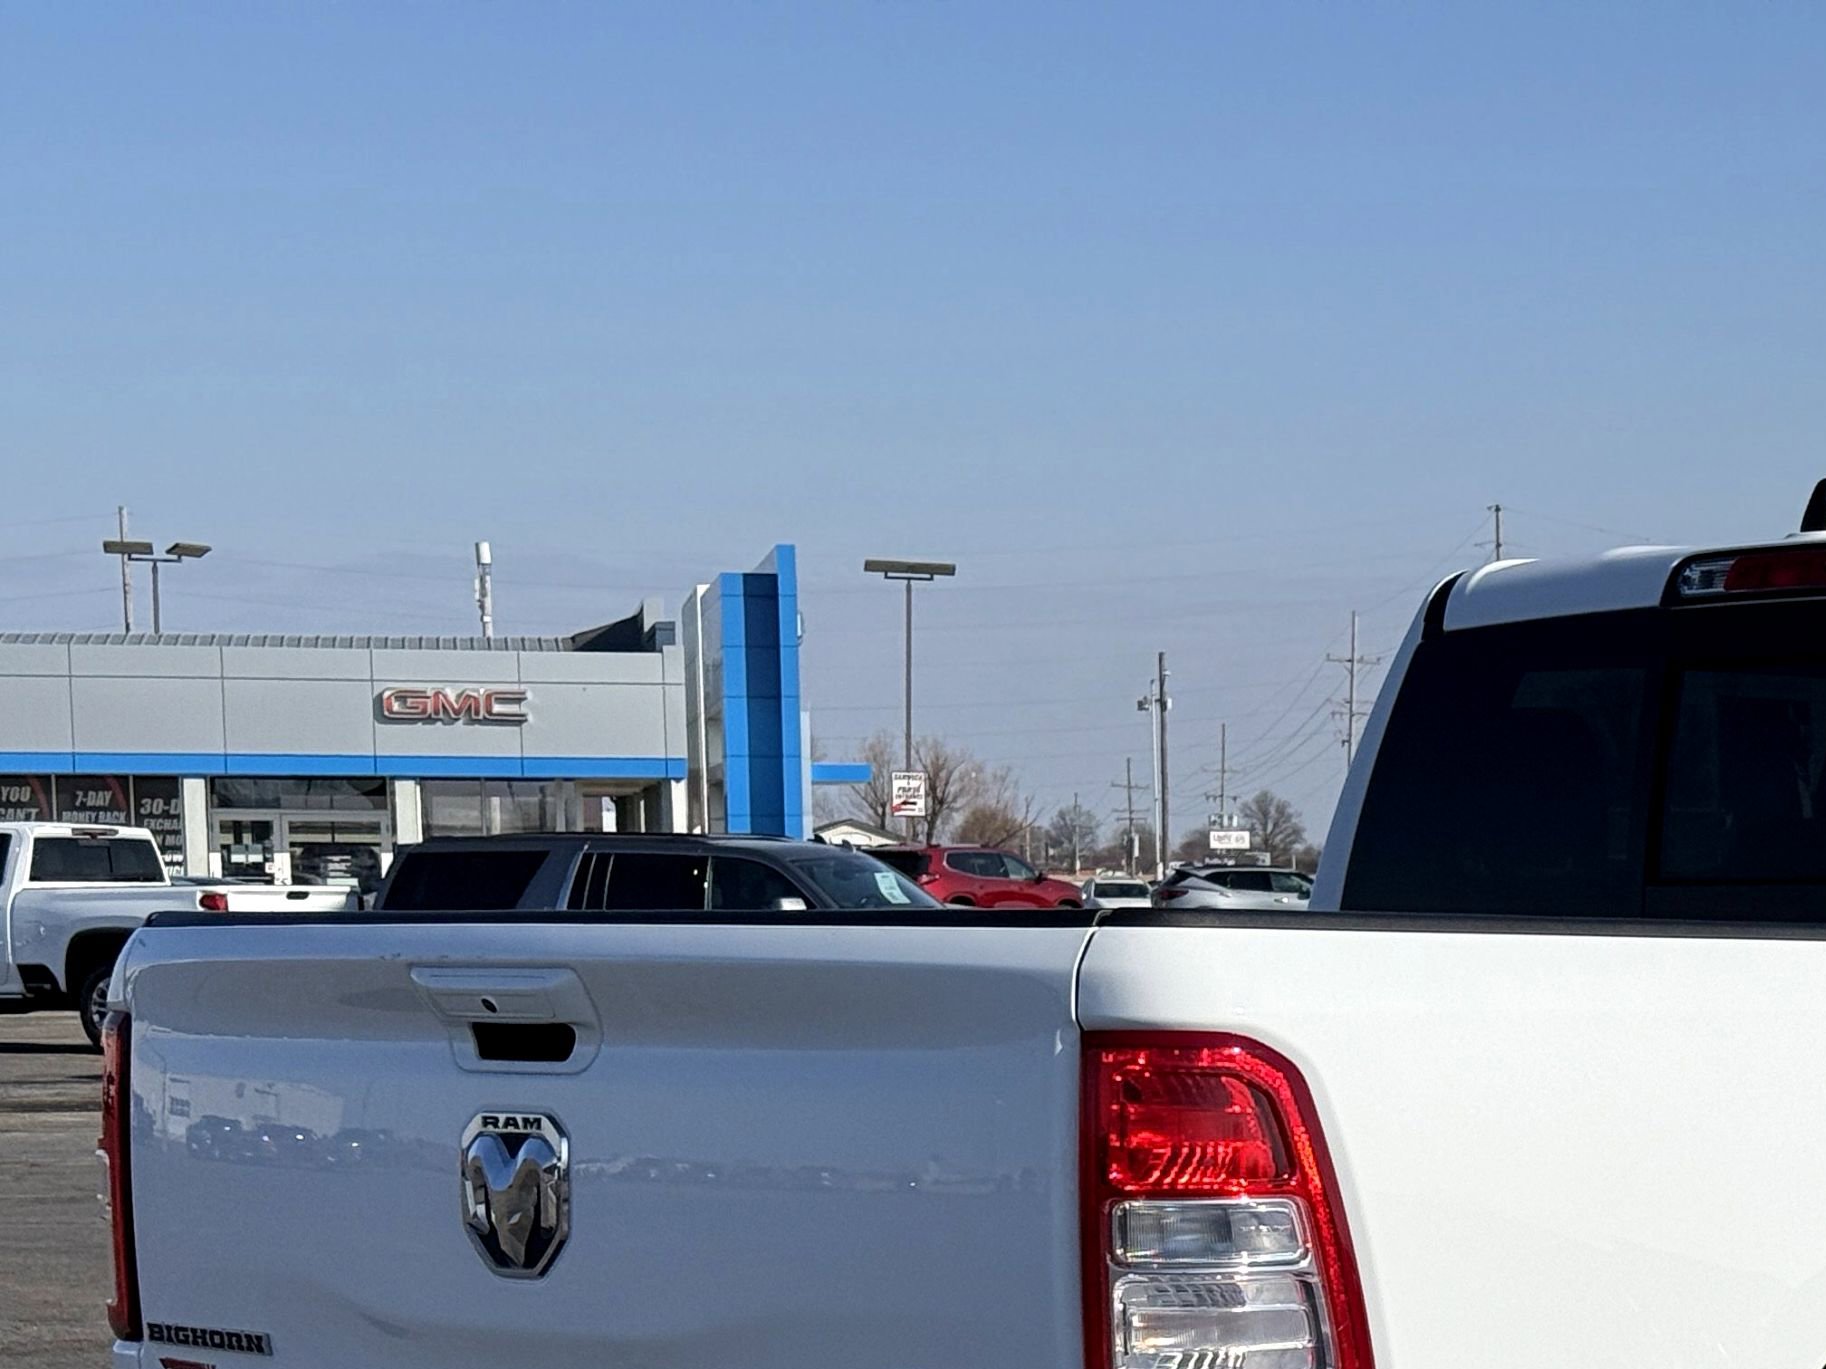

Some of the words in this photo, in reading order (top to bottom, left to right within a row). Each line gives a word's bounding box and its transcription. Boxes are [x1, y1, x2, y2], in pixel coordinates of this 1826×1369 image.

[383, 688, 528, 721] GMC
[1, 785, 31, 802] YOU
[74, 790, 113, 807] 7-DAY
[62, 811, 96, 822] MONEY
[98, 811, 127, 824] BACK
[481, 1115, 542, 1130] RAM
[147, 1322, 266, 1354] BIGHORN
